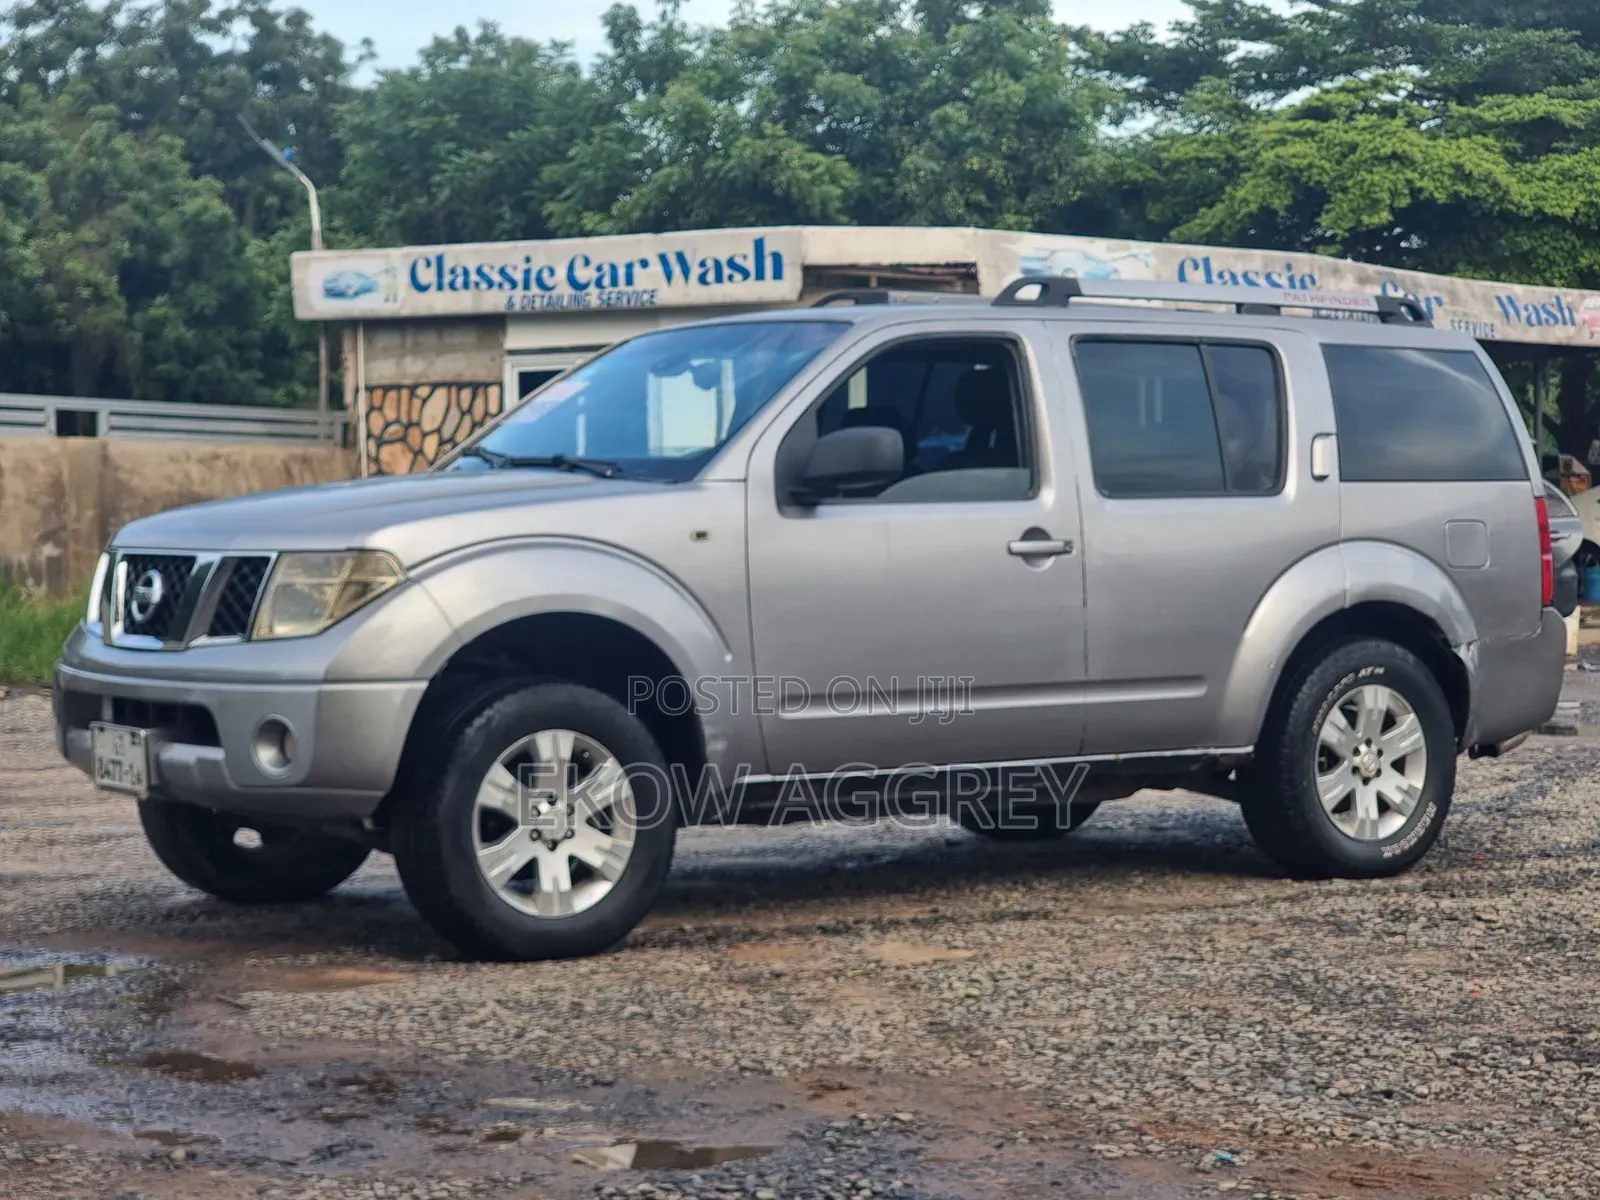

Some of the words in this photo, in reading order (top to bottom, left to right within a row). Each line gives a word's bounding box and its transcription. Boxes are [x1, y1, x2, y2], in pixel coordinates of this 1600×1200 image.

[409, 252, 557, 292] Classic
[566, 252, 650, 292] Car
[658, 236, 784, 288] Wash
[520, 291, 592, 310] DETAILING
[598, 289, 658, 306] SERVICE
[1494, 294, 1577, 328] Wash
[1450, 319, 1496, 338] SERVICE
